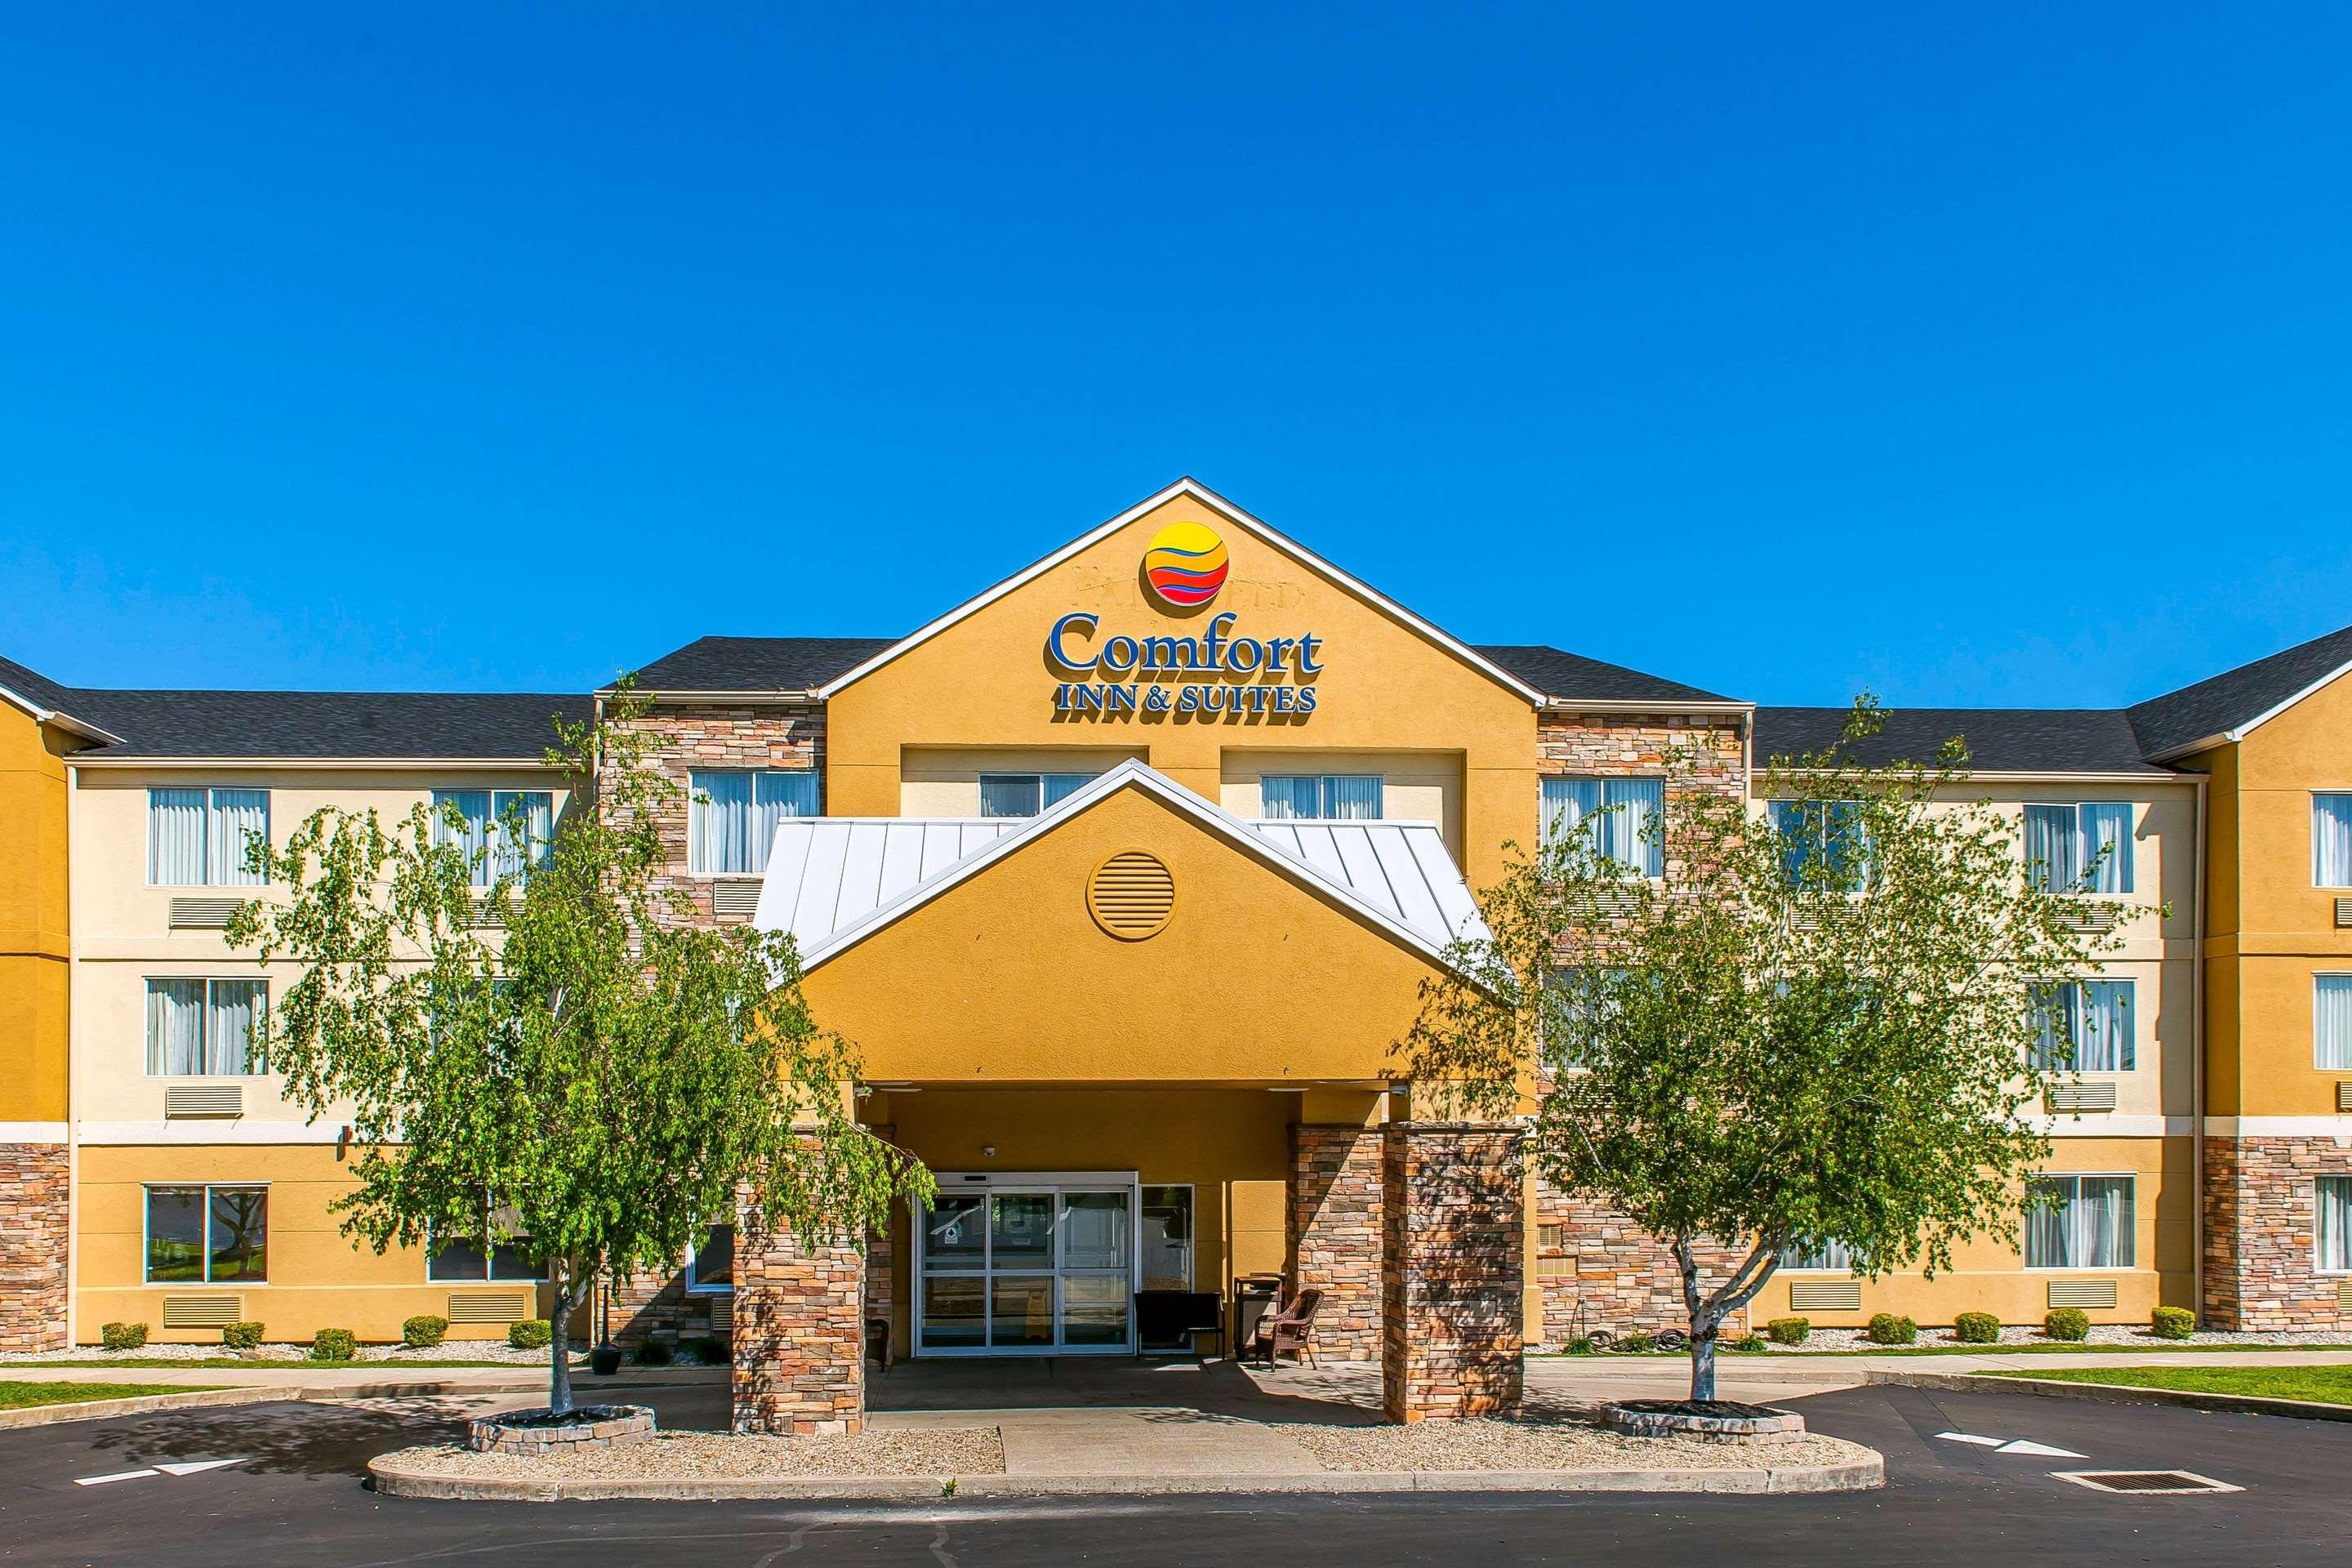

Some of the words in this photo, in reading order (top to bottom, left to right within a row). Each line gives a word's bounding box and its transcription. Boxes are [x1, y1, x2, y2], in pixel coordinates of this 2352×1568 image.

[1050, 612, 1324, 673] Comfort
[1058, 684, 1138, 710] INN
[1147, 684, 1170, 710] &
[1182, 685, 1316, 711] SUITES
